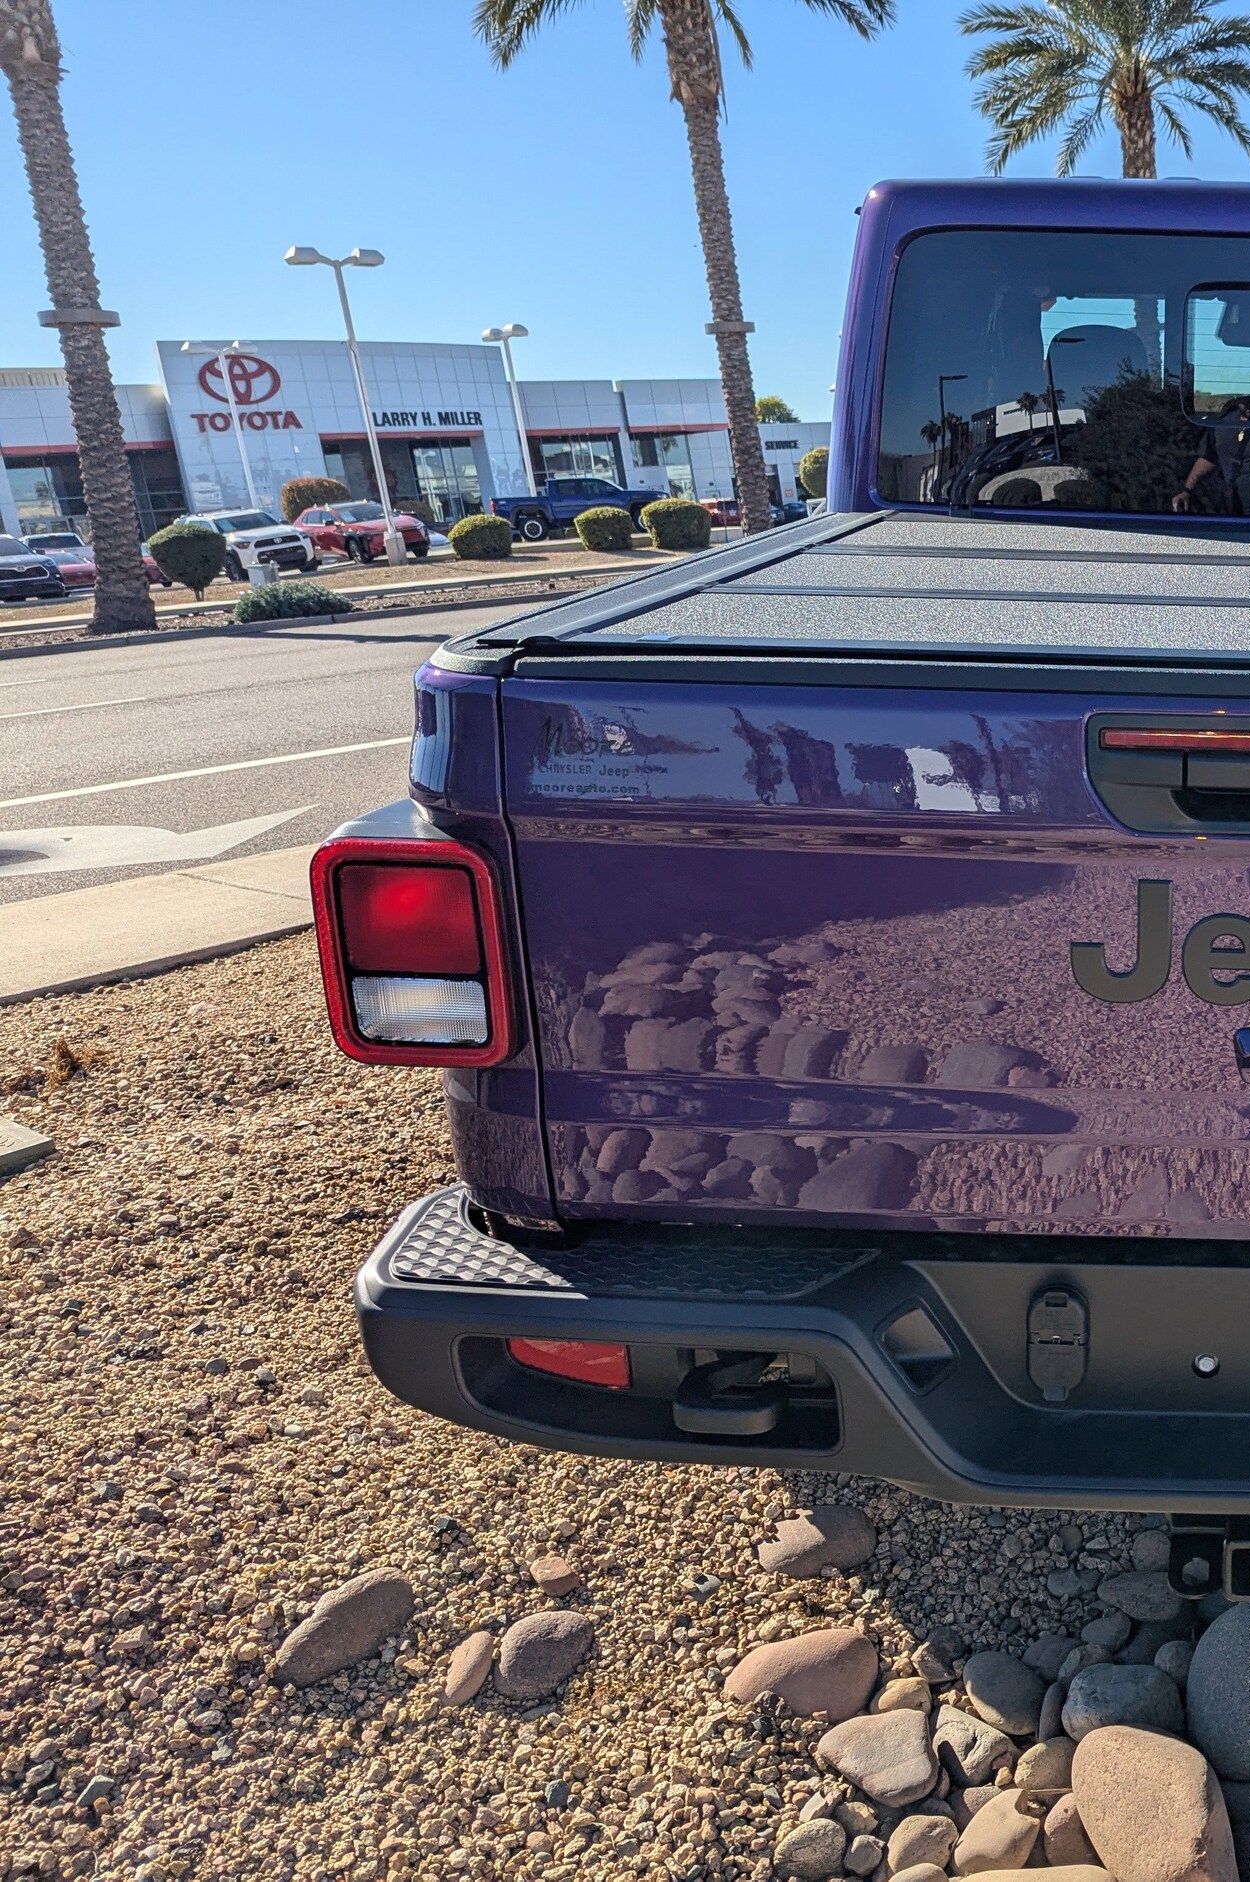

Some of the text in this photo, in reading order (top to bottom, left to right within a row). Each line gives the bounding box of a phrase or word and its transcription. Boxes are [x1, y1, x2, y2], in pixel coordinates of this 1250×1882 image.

[190, 411, 303, 432] TOYOTA
[372, 411, 483, 427] LARRY H. MILLER
[765, 440, 800, 450] SERVICE
[599, 764, 630, 779] Jeep
[531, 783, 640, 794] mooreauto.com
